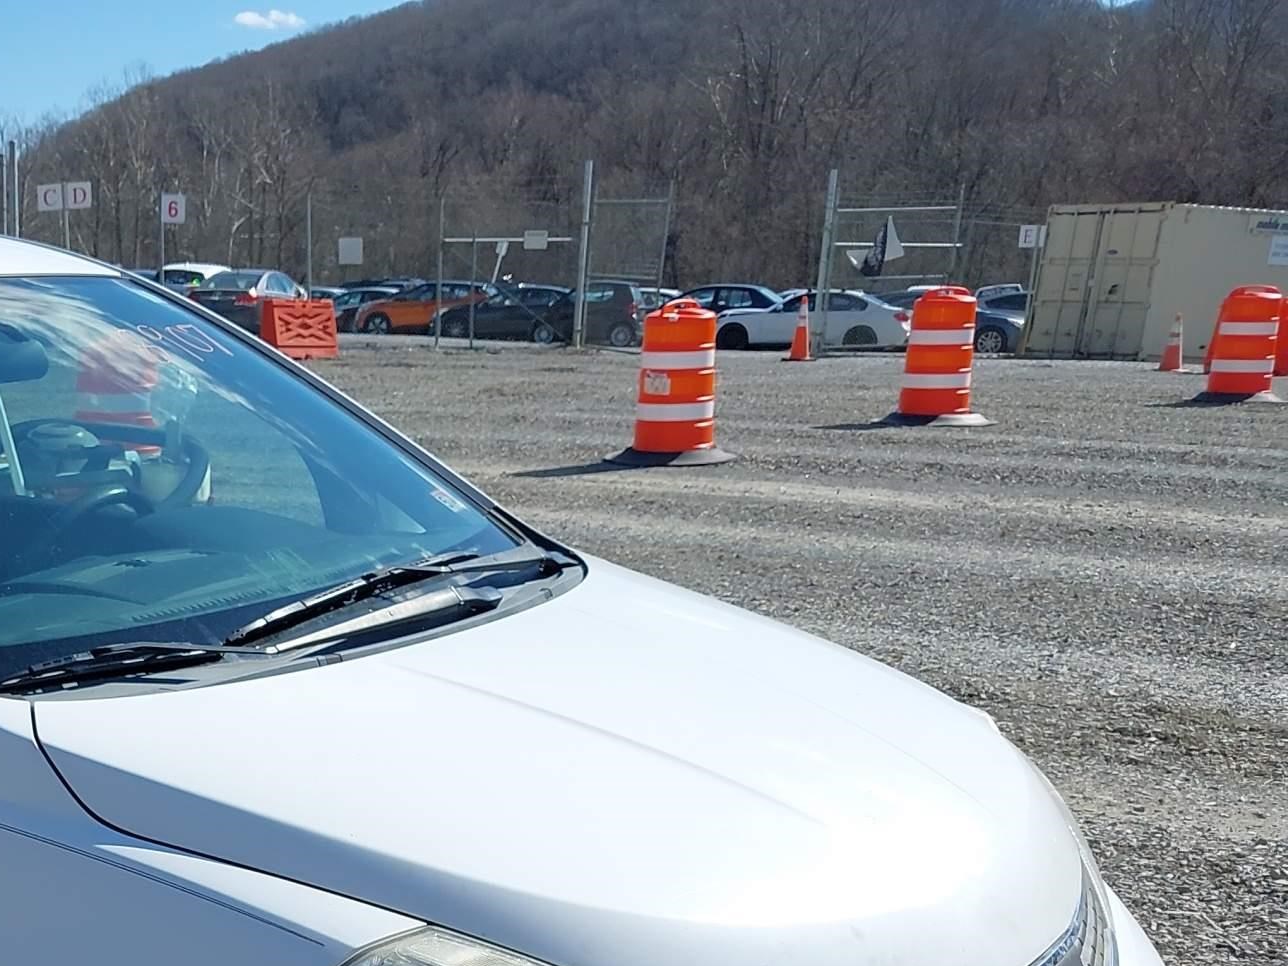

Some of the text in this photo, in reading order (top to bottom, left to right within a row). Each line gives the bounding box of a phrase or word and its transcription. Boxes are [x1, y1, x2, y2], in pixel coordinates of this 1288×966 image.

[43, 188, 57, 207] C
[72, 187, 87, 205] D
[168, 201, 179, 218] 6
[1023, 228, 1034, 244] E
